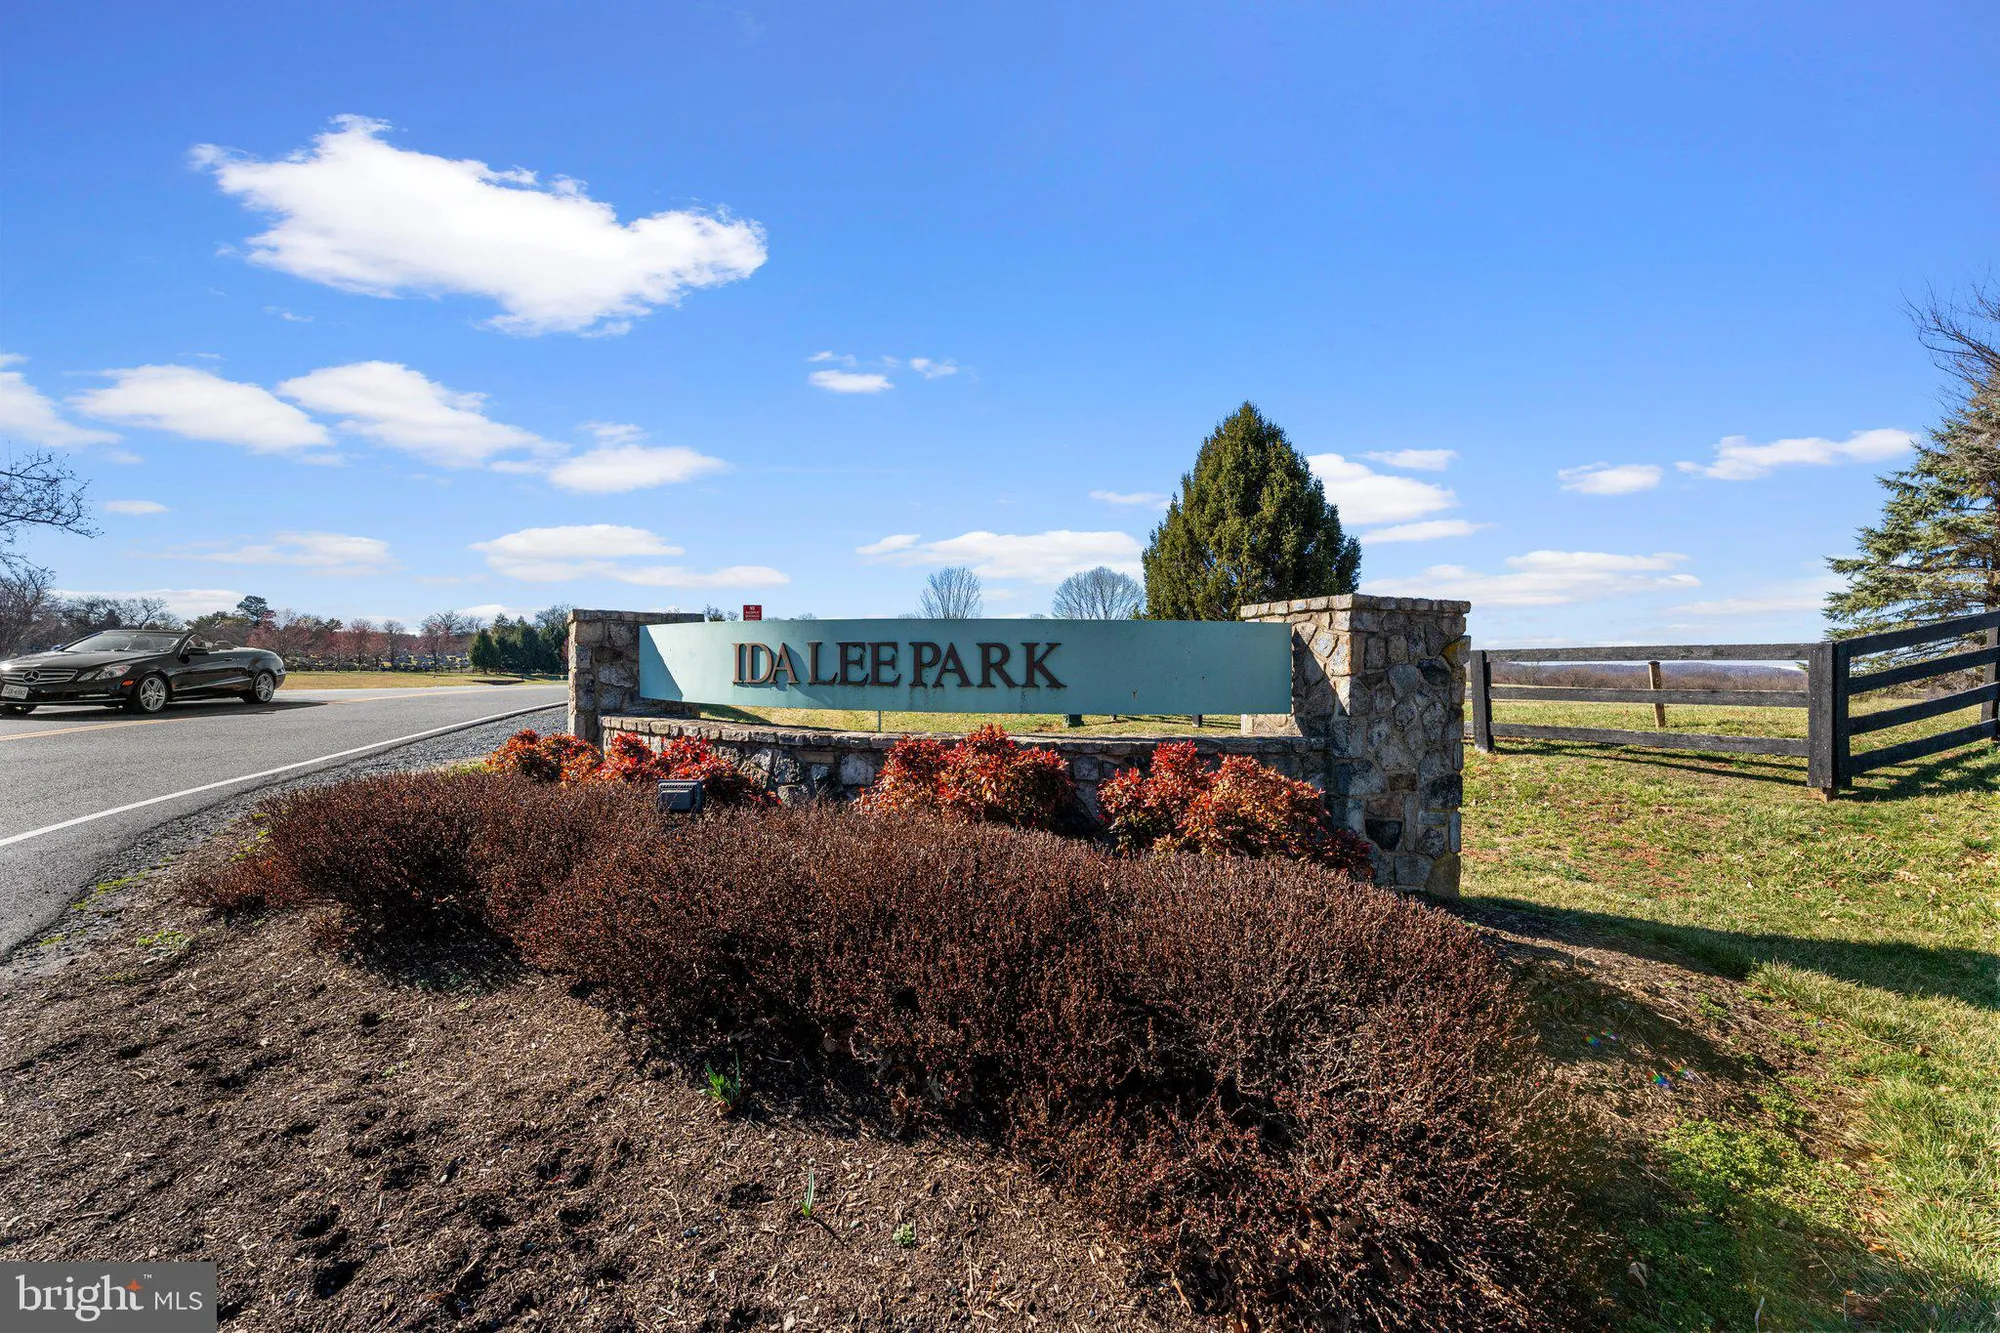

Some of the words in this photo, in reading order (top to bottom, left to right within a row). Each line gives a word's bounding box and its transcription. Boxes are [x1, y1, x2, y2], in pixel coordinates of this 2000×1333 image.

[732, 642, 798, 685] IDA
[807, 641, 901, 688] LEE
[909, 641, 1068, 689] PARK
